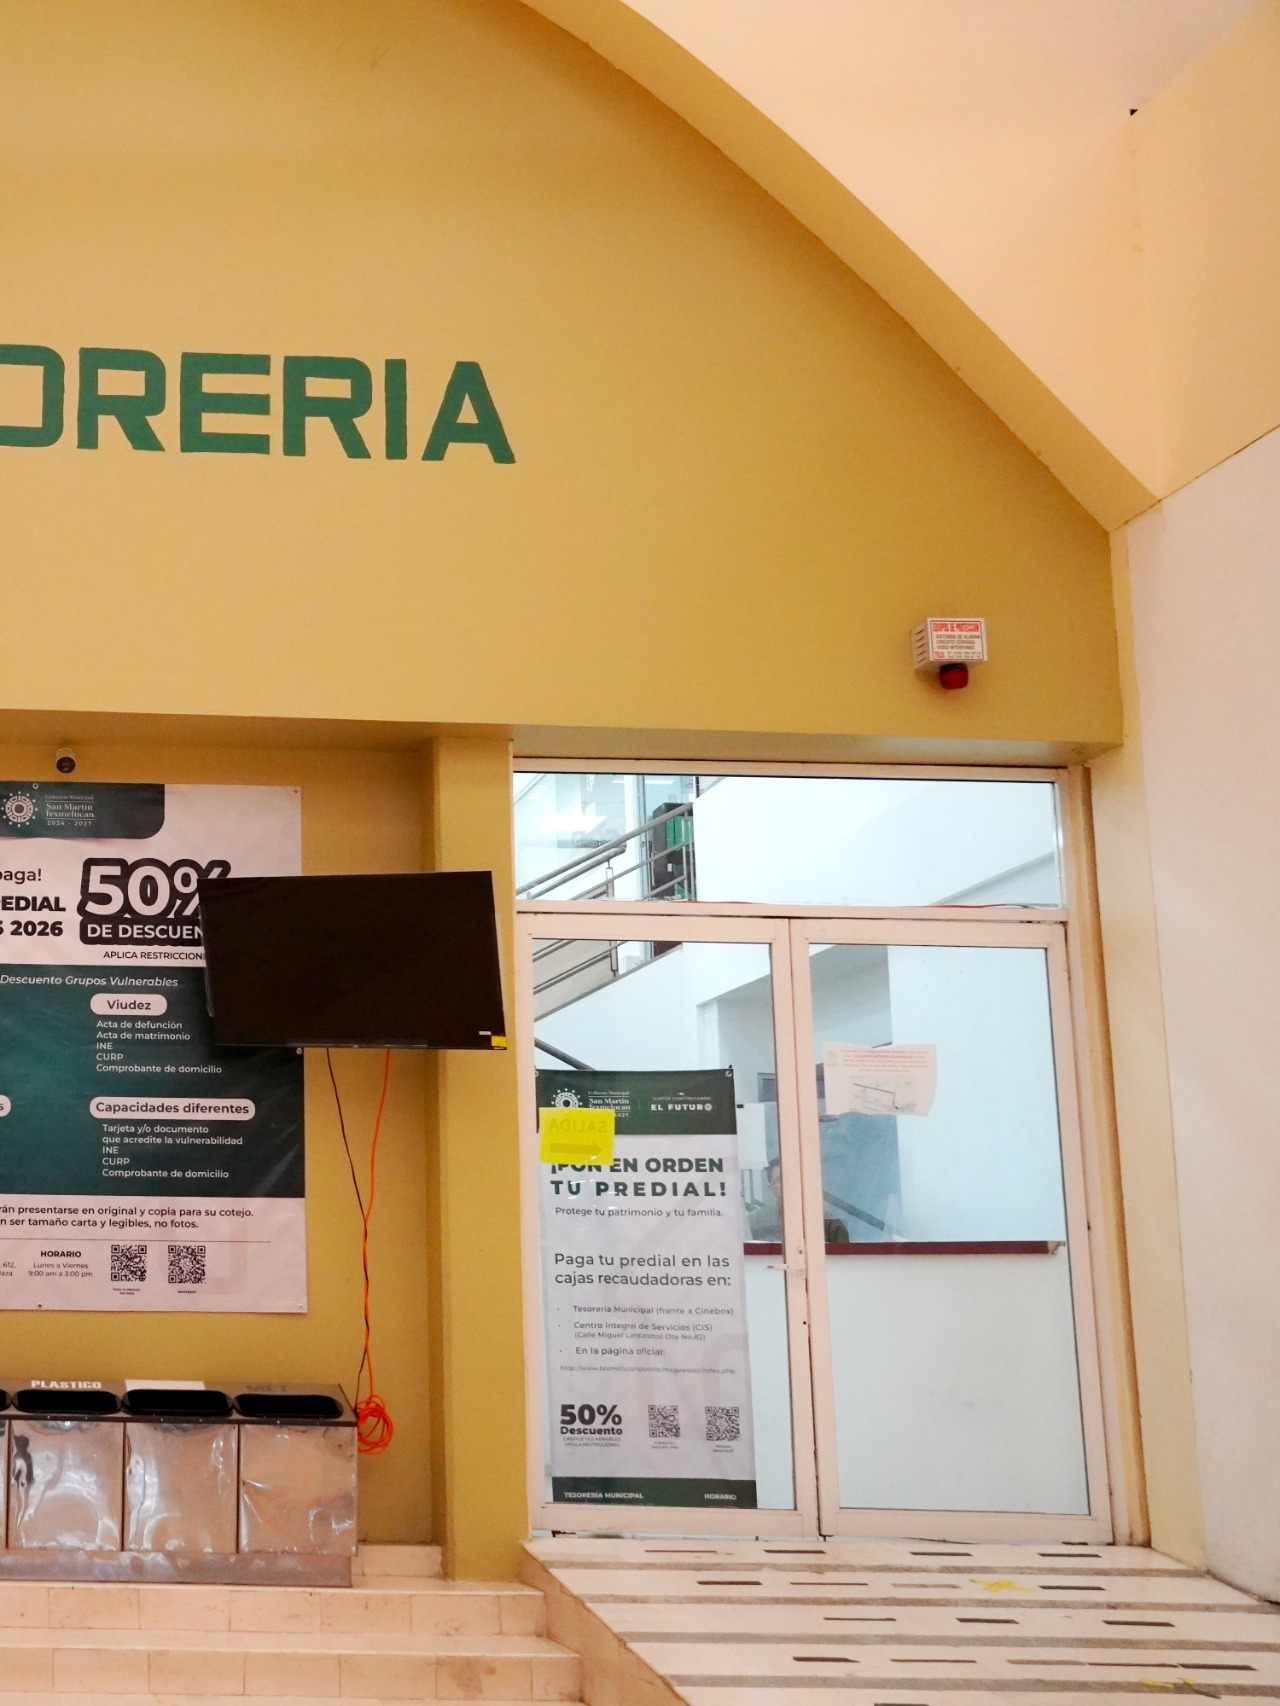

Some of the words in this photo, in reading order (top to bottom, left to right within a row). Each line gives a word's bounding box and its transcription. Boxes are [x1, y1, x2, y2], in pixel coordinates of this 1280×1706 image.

[10, 921, 63, 936] 2026
[88, 924, 112, 937] DE
[103, 951, 138, 959] APLICA
[140, 952, 206, 960] RESTRICCION
[0, 975, 62, 985] Descuento
[65, 975, 106, 987] Grupos
[110, 977, 178, 987] Vulnerables
[107, 1000, 151, 1010] Viudez
[135, 1021, 182, 1029] defunción
[135, 1032, 190, 1040] matrimonio
[96, 1053, 123, 1061] CURP
[96, 1065, 161, 1073] Comprobante
[164, 1065, 176, 1073] de
[96, 1102, 179, 1113] Capacidades
[183, 1103, 249, 1114] diferentes
[610, 1158, 638, 1173] EN
[645, 1158, 723, 1173] ORDEN
[550, 1181, 581, 1195] TU
[596, 1182, 726, 1197] PREDIAL!
[18, 1205, 79, 1215] presentarse
[98, 1206, 137, 1217] original
[148, 1207, 176, 1218] copia
[219, 1208, 254, 1218] cotejo.
[10, 1218, 25, 1226] ser
[28, 1217, 68, 1227] tamaño
[71, 1219, 97, 1227] carta
[109, 1219, 151, 1229] legibles,
[171, 1219, 198, 1228] fotos.
[40, 1250, 82, 1258] HORARIO
[555, 1253, 594, 1268] Paga
[599, 1255, 614, 1266] tu
[620, 1254, 675, 1268] predial
[681, 1257, 702, 1267] en
[708, 1255, 730, 1267] las
[555, 1272, 593, 1286] cajas
[598, 1272, 702, 1286] recaudadoras
[707, 1275, 731, 1286] en:
[31, 1380, 102, 1389] PLASTICO
[560, 1403, 622, 1426] 50%
[560, 1426, 623, 1435] Descuento
[564, 1491, 603, 1499] TESORERÍA
